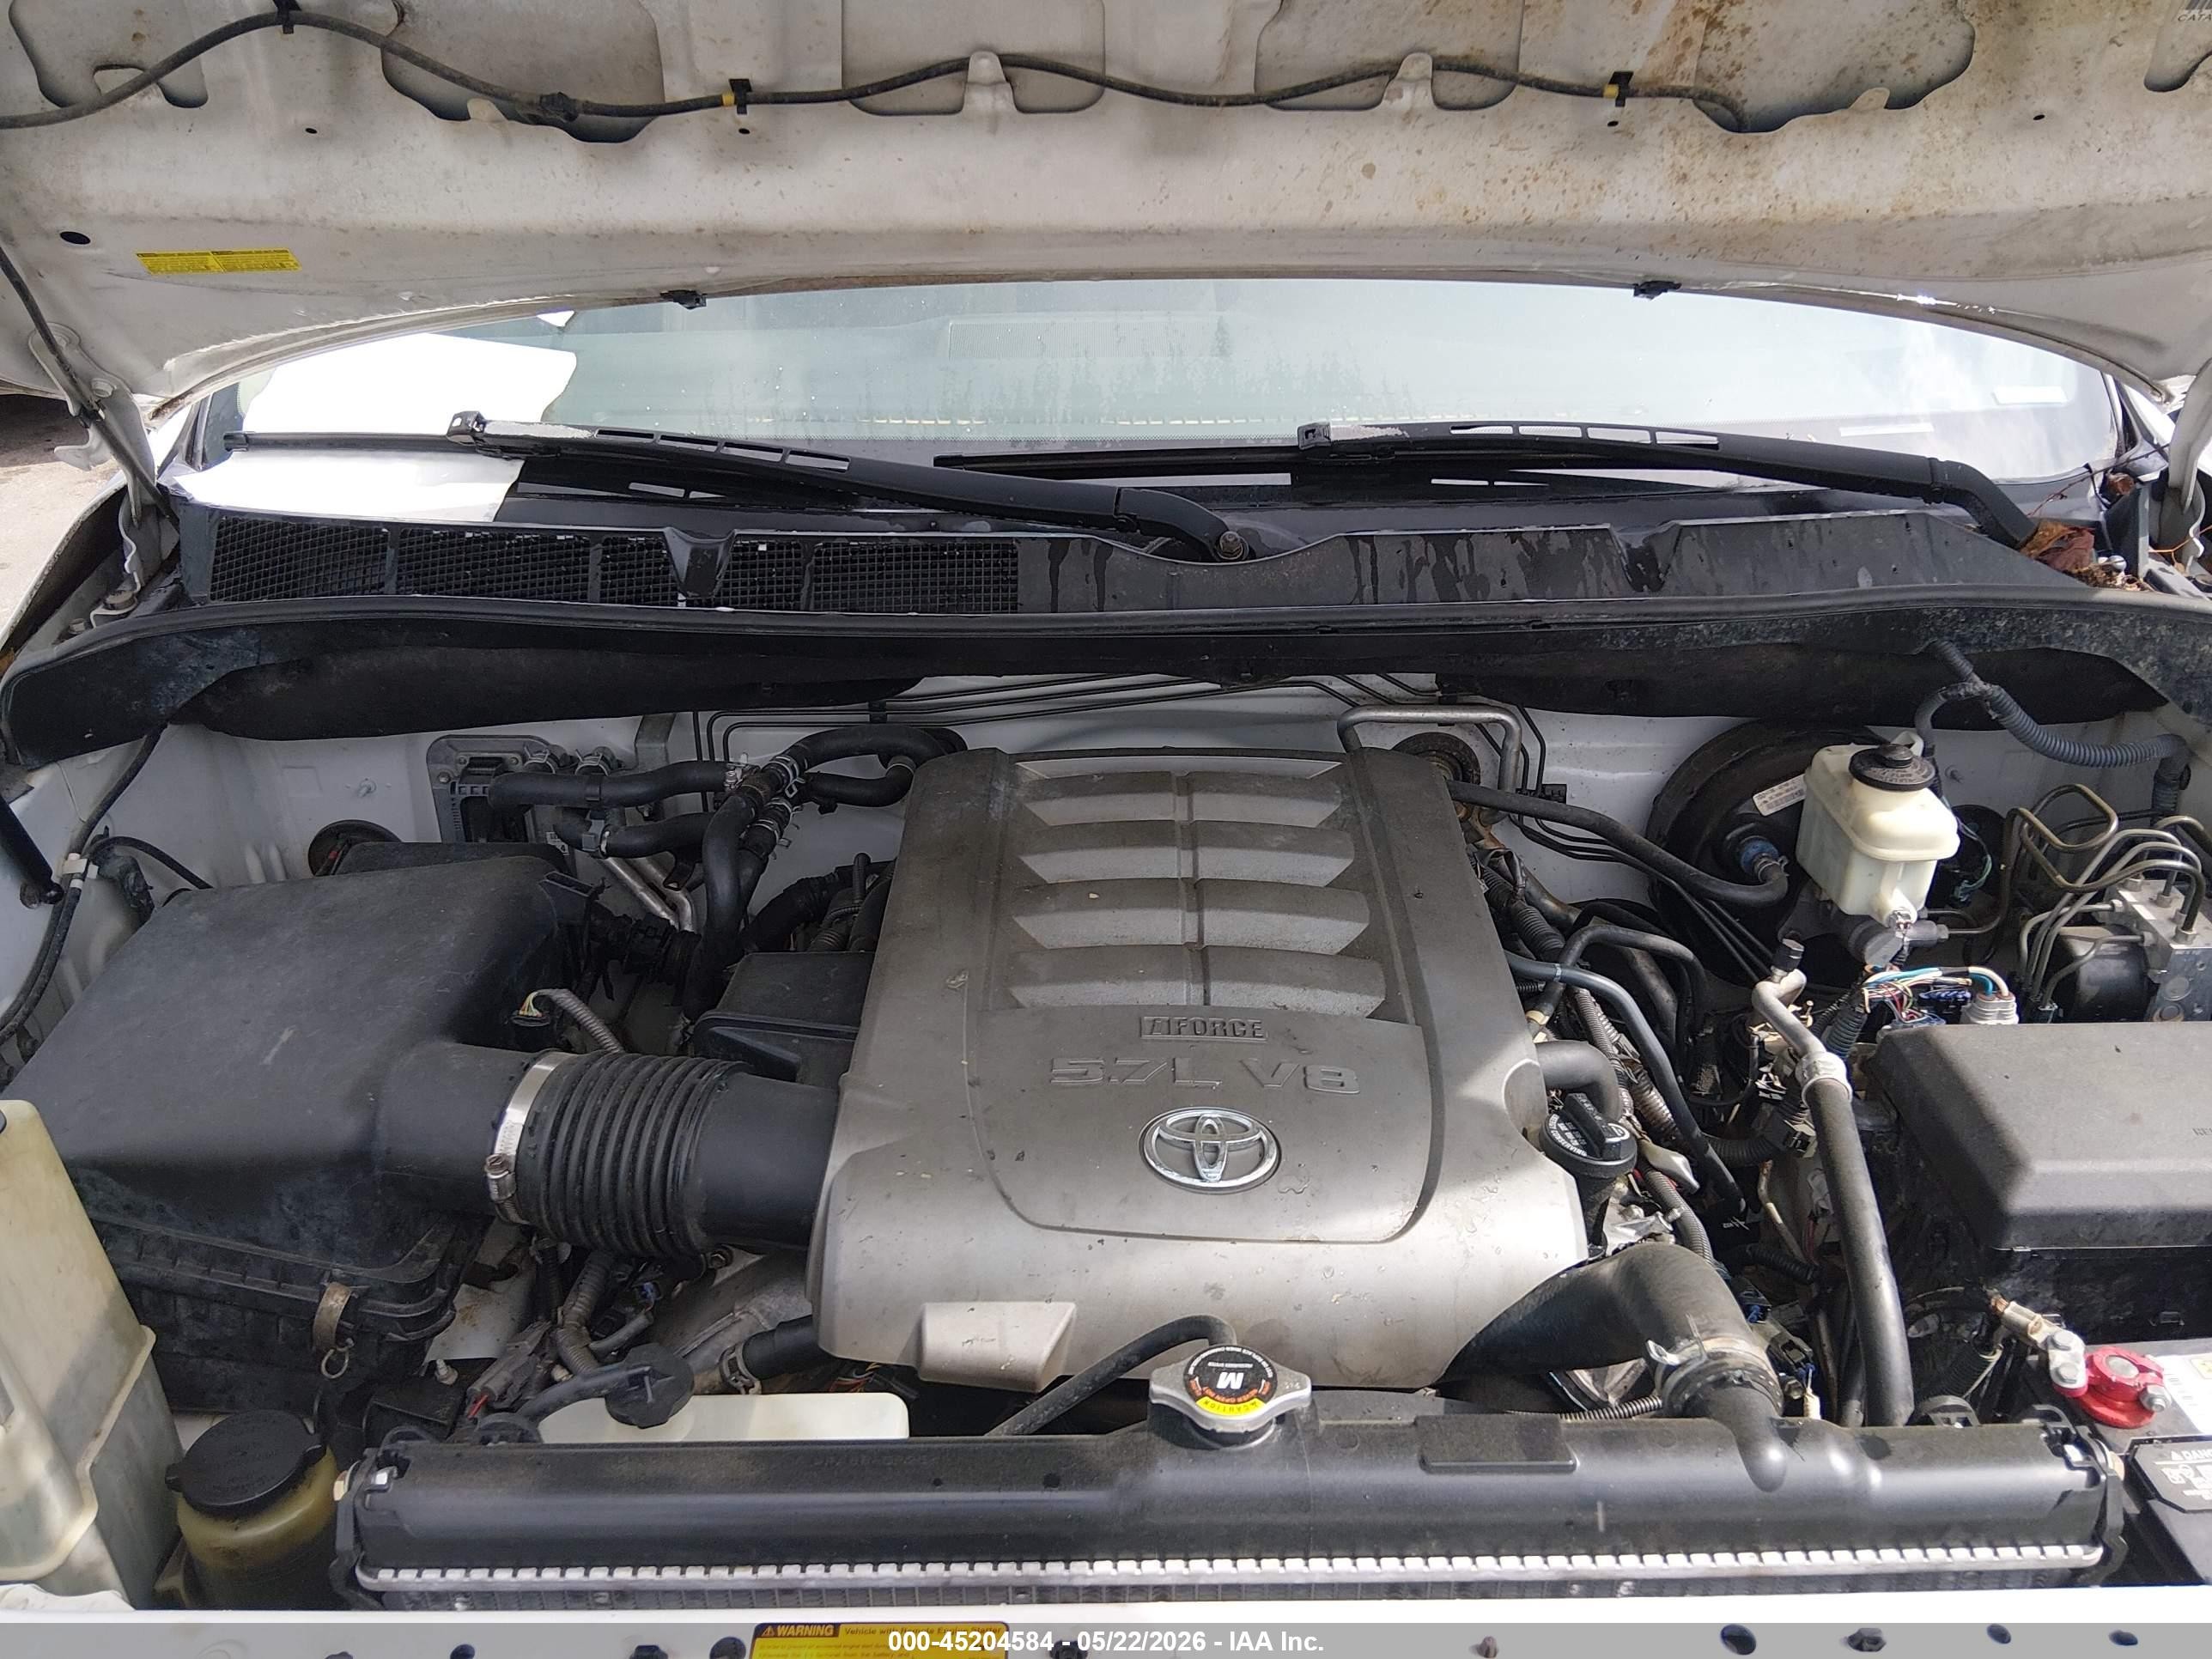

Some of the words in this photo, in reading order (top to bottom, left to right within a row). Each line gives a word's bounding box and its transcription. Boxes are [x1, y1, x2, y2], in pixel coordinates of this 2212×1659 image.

[1050, 1057, 1223, 1088] 5.7L
[1240, 1058, 1361, 1095] V8
[1551, 1130, 1588, 1157] CONSERVING
[776, 1625, 834, 1638] WARNING
[844, 1627, 876, 1636] Vehicle
